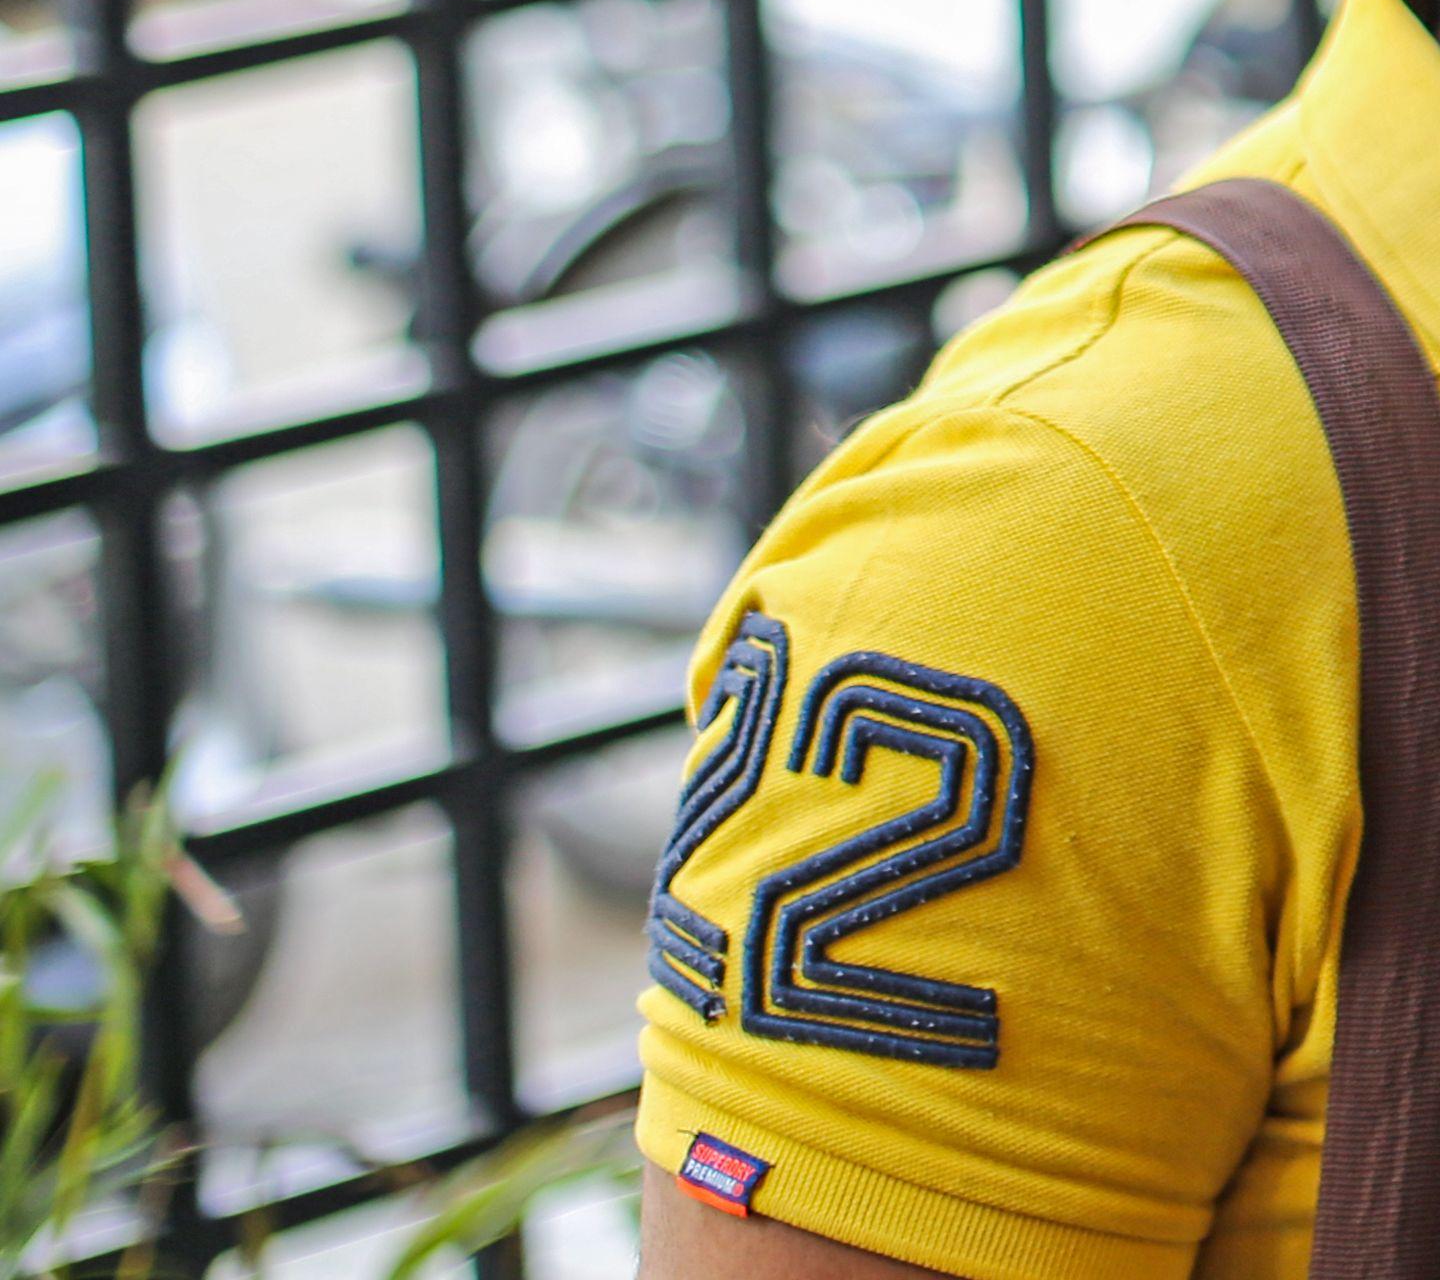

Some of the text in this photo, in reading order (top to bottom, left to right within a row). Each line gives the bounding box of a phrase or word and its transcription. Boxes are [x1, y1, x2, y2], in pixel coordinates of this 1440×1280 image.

[649, 610, 1036, 1070] 22
[683, 1158, 737, 1195] PREMIUM
[692, 1143, 757, 1182] SUPERDRY
